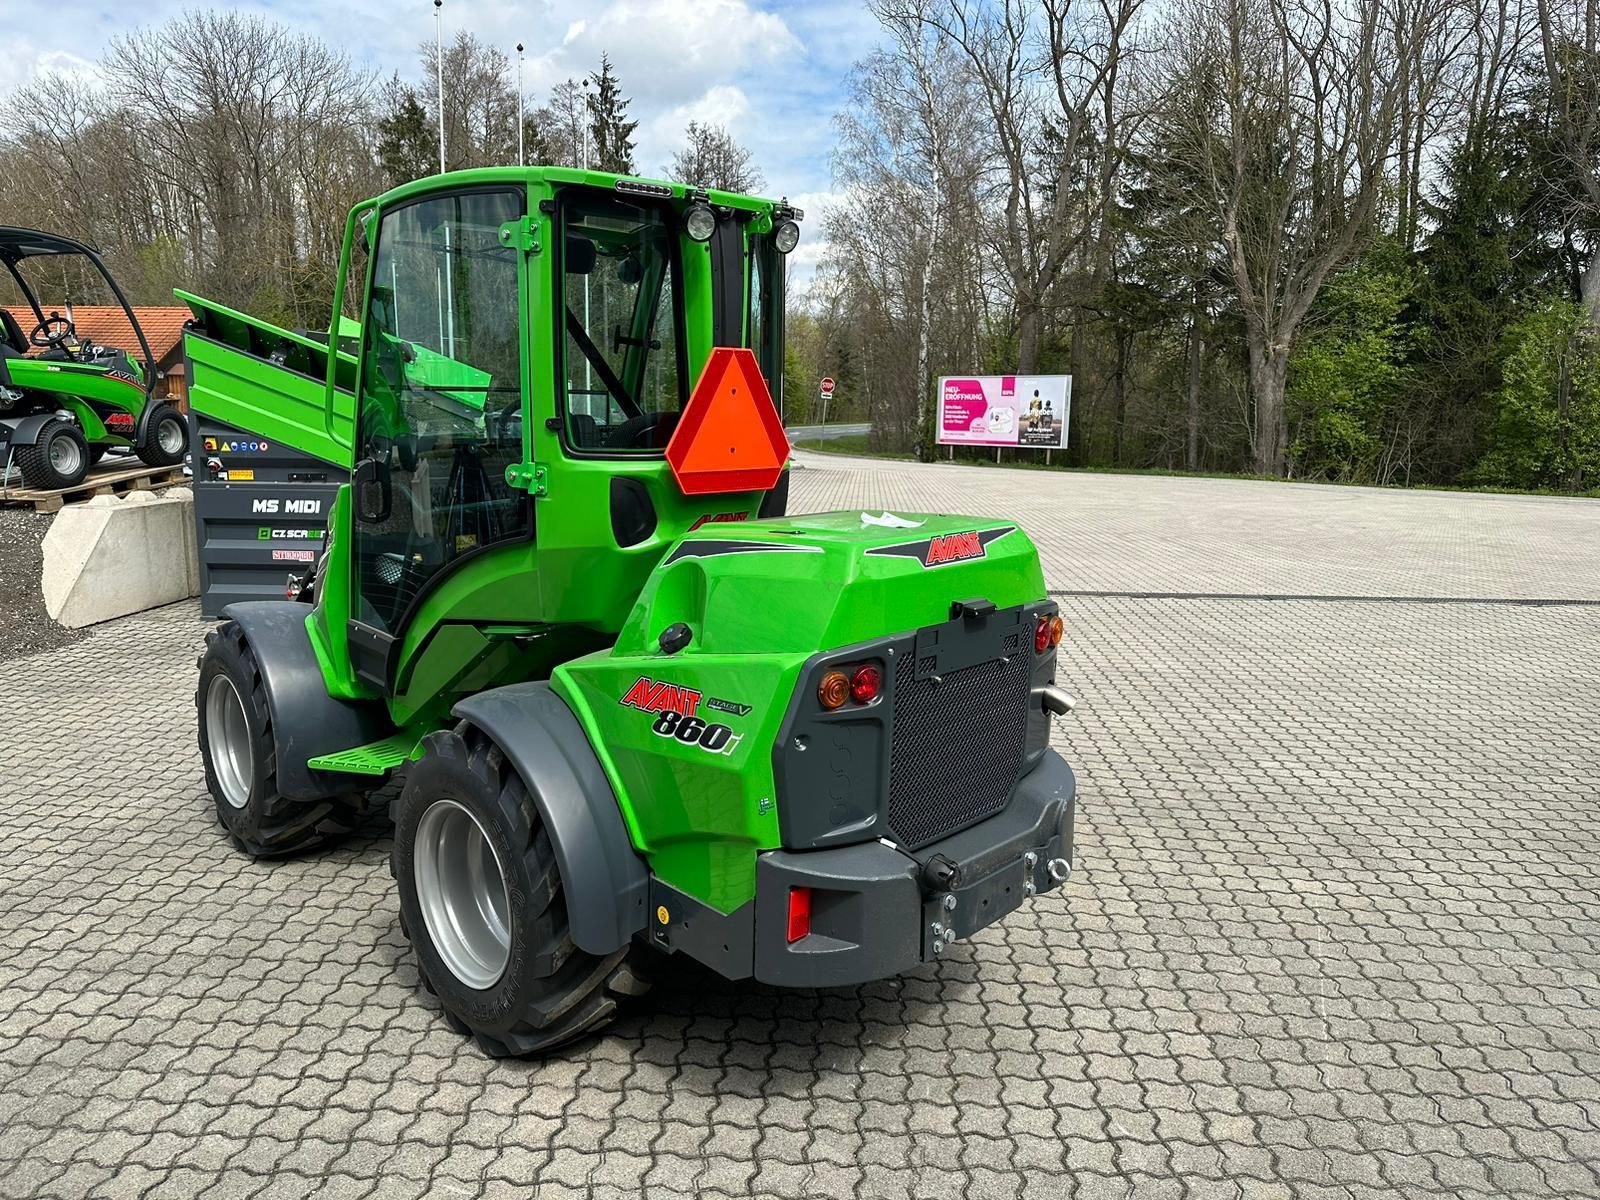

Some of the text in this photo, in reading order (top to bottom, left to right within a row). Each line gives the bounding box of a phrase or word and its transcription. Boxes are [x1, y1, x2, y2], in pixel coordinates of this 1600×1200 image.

[252, 499, 321, 514] MS MIDI
[925, 530, 984, 566] AVANT
[620, 676, 702, 717] AVANT
